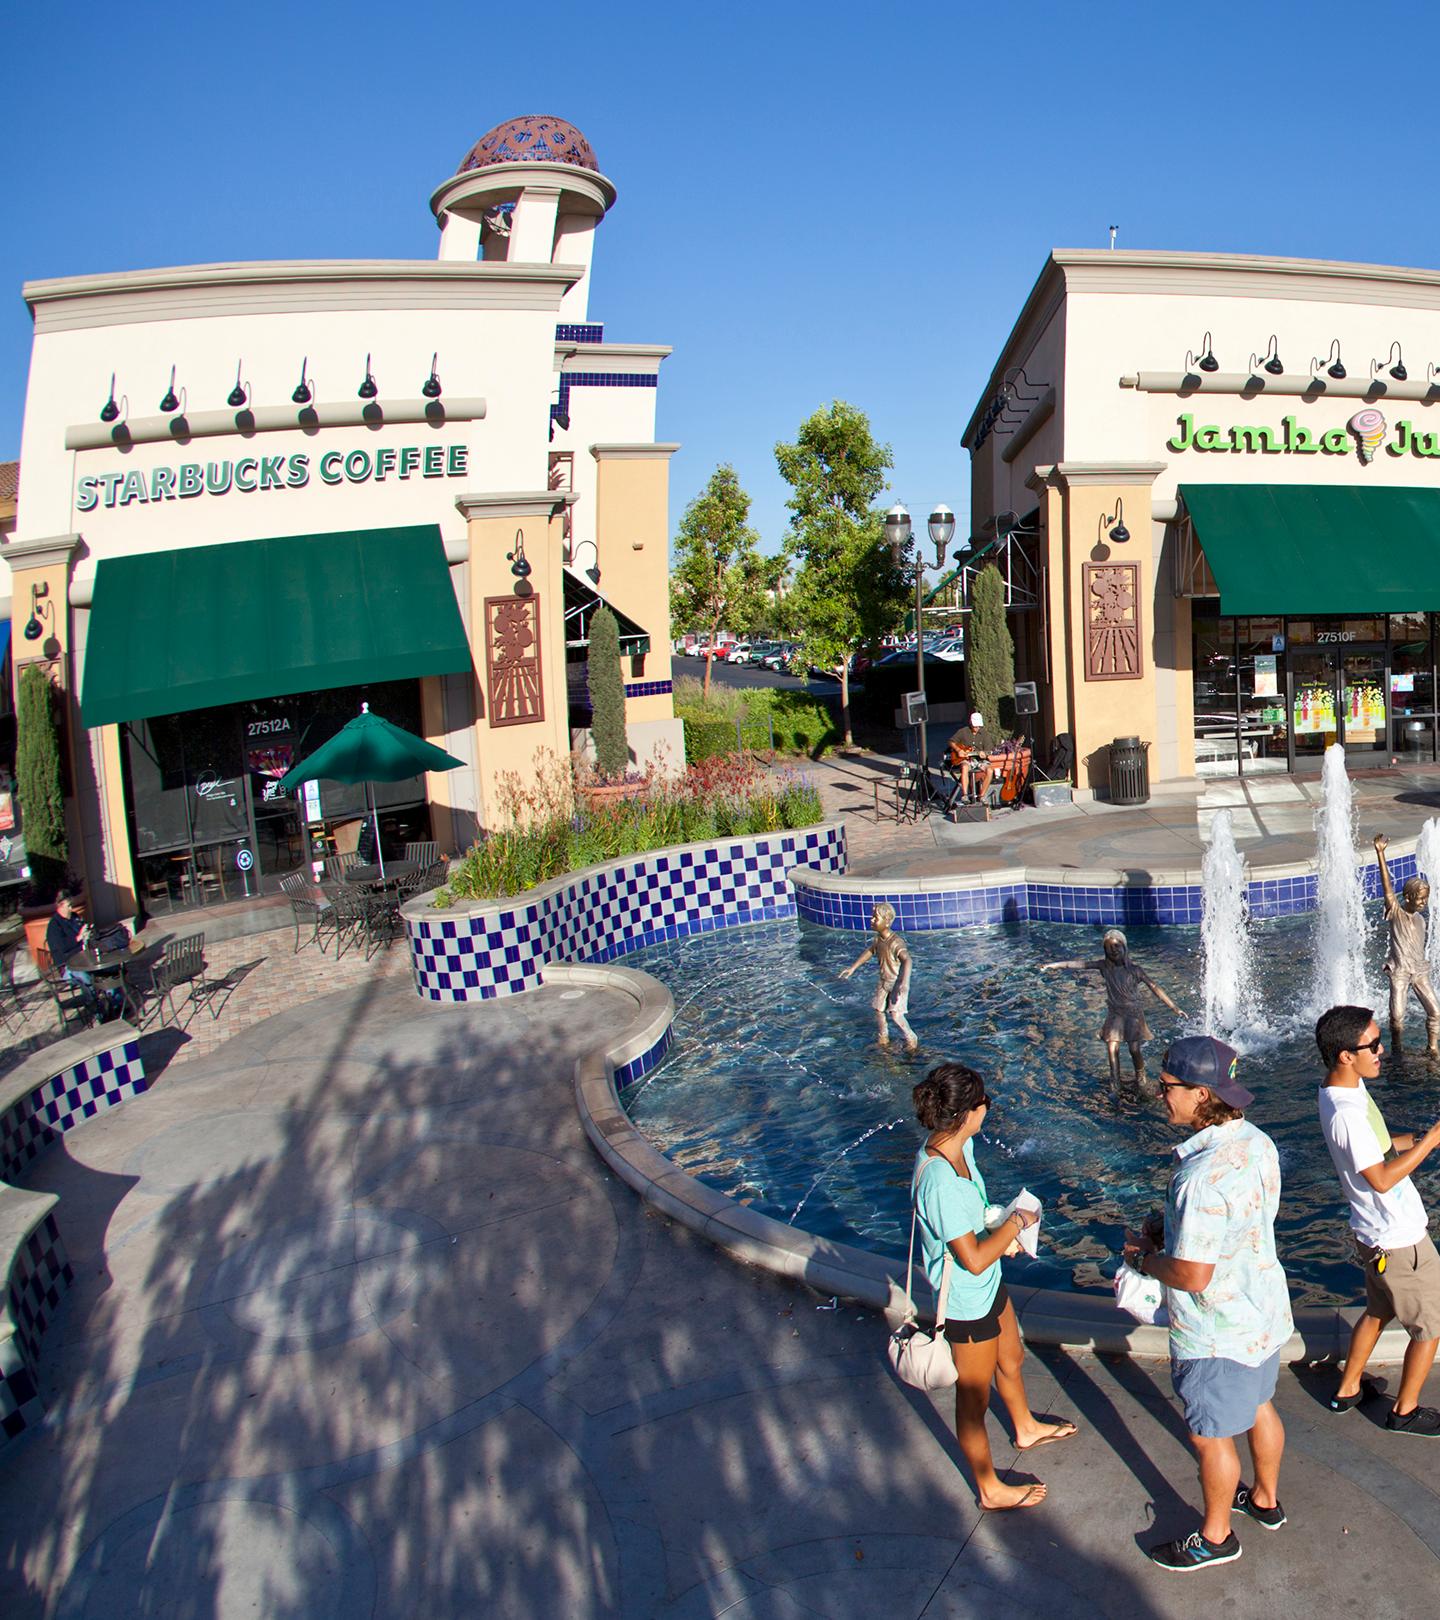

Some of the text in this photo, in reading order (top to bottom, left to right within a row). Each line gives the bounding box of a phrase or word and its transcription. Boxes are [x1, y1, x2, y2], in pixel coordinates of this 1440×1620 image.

[1168, 413, 1354, 454] Jamba
[76, 445, 469, 511] STARBUCKS COFFEE
[1317, 631, 1356, 643] 27510F
[248, 718, 290, 736] 27512A
